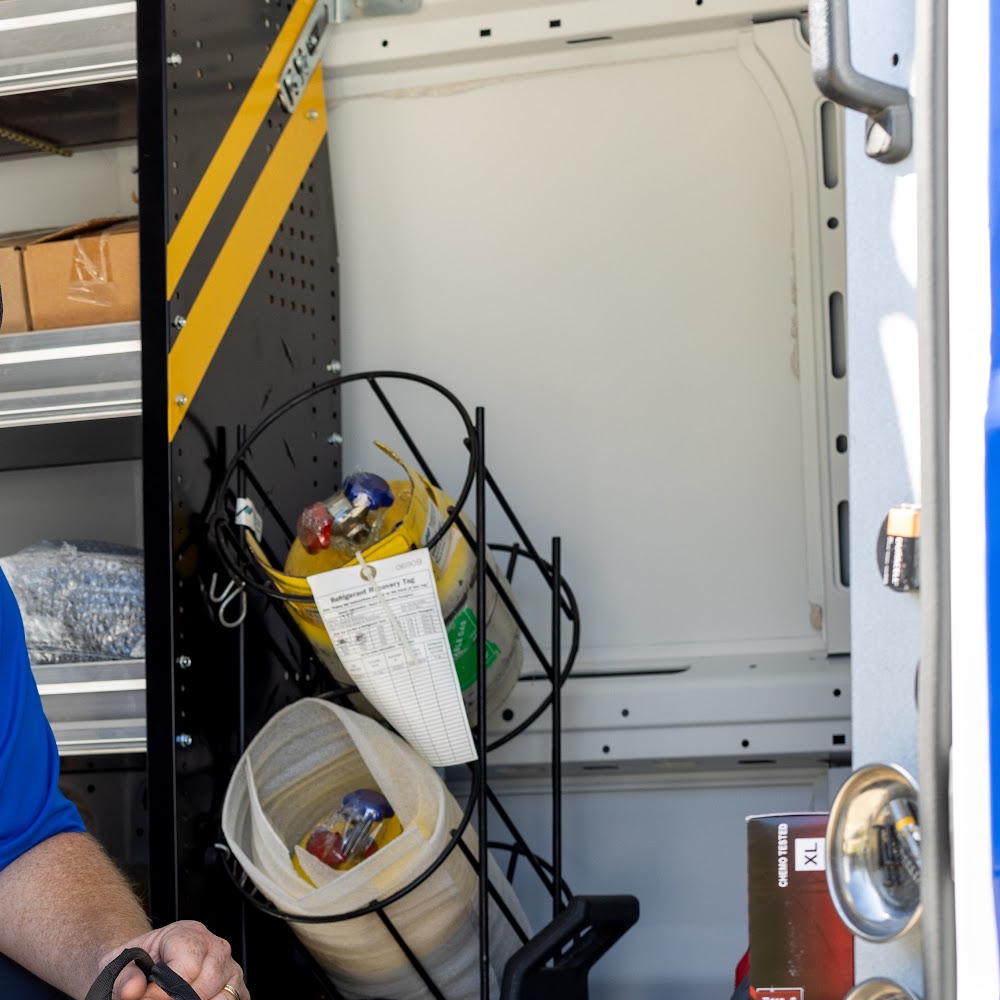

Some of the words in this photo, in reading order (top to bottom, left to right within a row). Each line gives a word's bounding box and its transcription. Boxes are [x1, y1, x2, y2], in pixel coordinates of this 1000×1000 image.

[330, 588, 367, 603] Refrigerant
[368, 581, 400, 594] Rcovery
[402, 577, 416, 586] Tag
[777, 822, 788, 857] TESTED
[804, 842, 818, 865] XL
[777, 856, 788, 888] CHEMO
